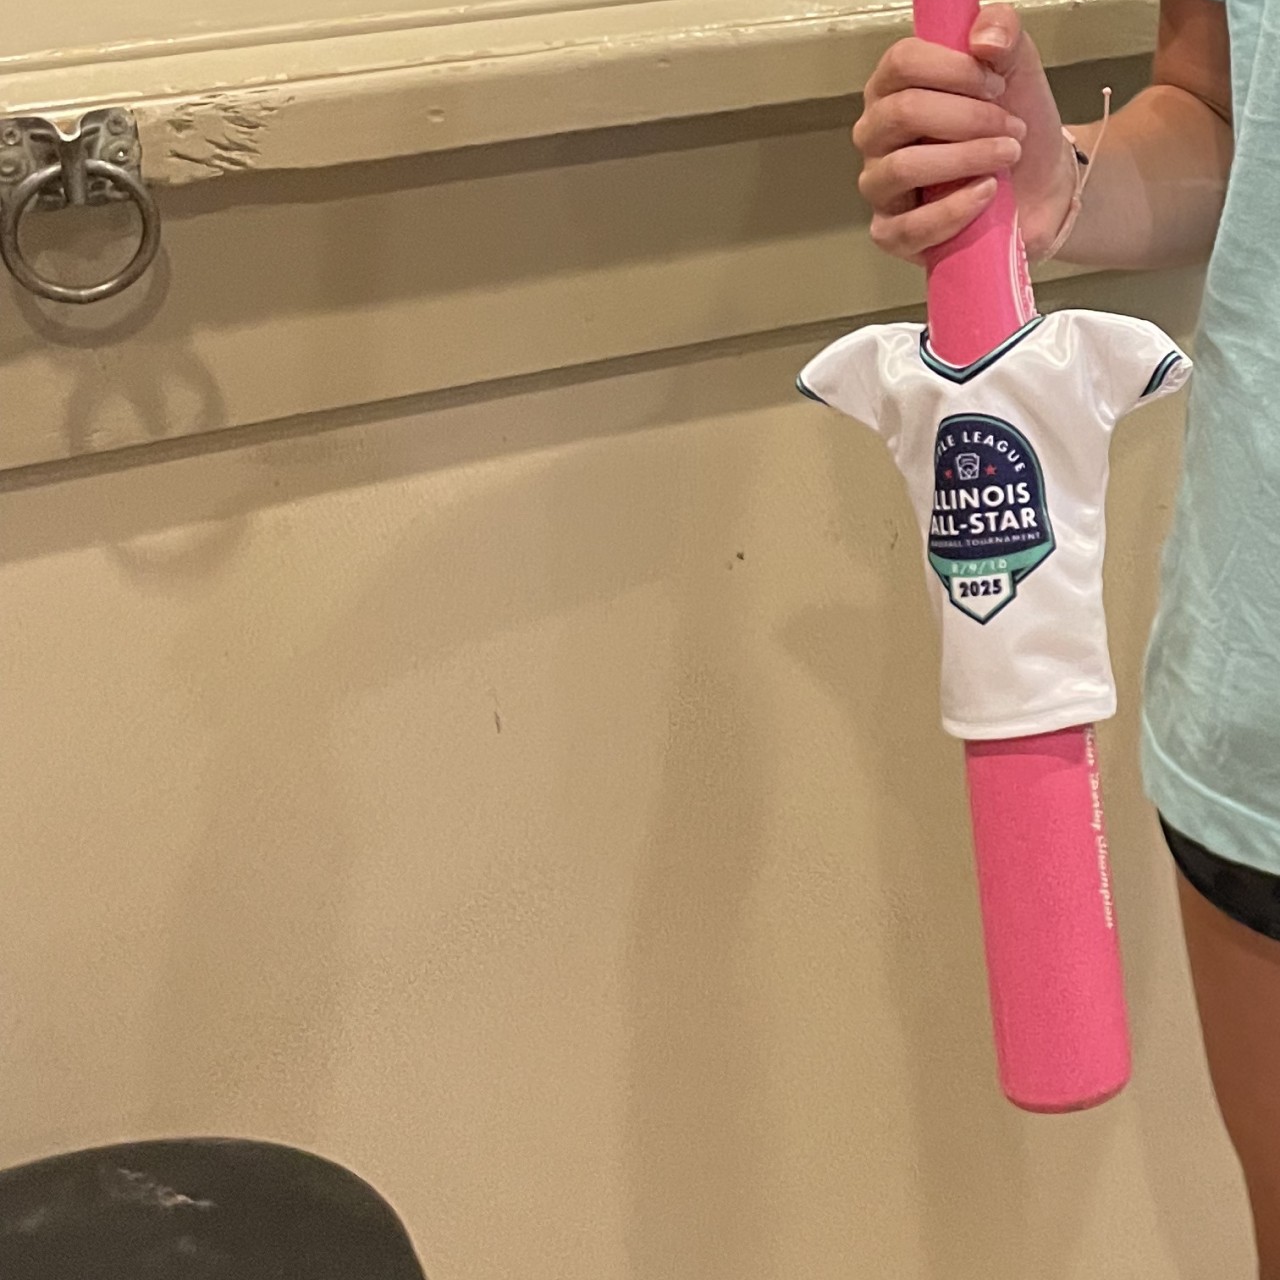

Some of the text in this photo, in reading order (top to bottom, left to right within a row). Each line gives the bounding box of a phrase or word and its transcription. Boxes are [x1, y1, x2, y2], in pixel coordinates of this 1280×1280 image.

[962, 431, 1026, 473] LEAGUE
[934, 482, 1031, 510] LLINOIS
[931, 507, 1038, 536] ALL-STAR
[959, 579, 1002, 598] 2025
